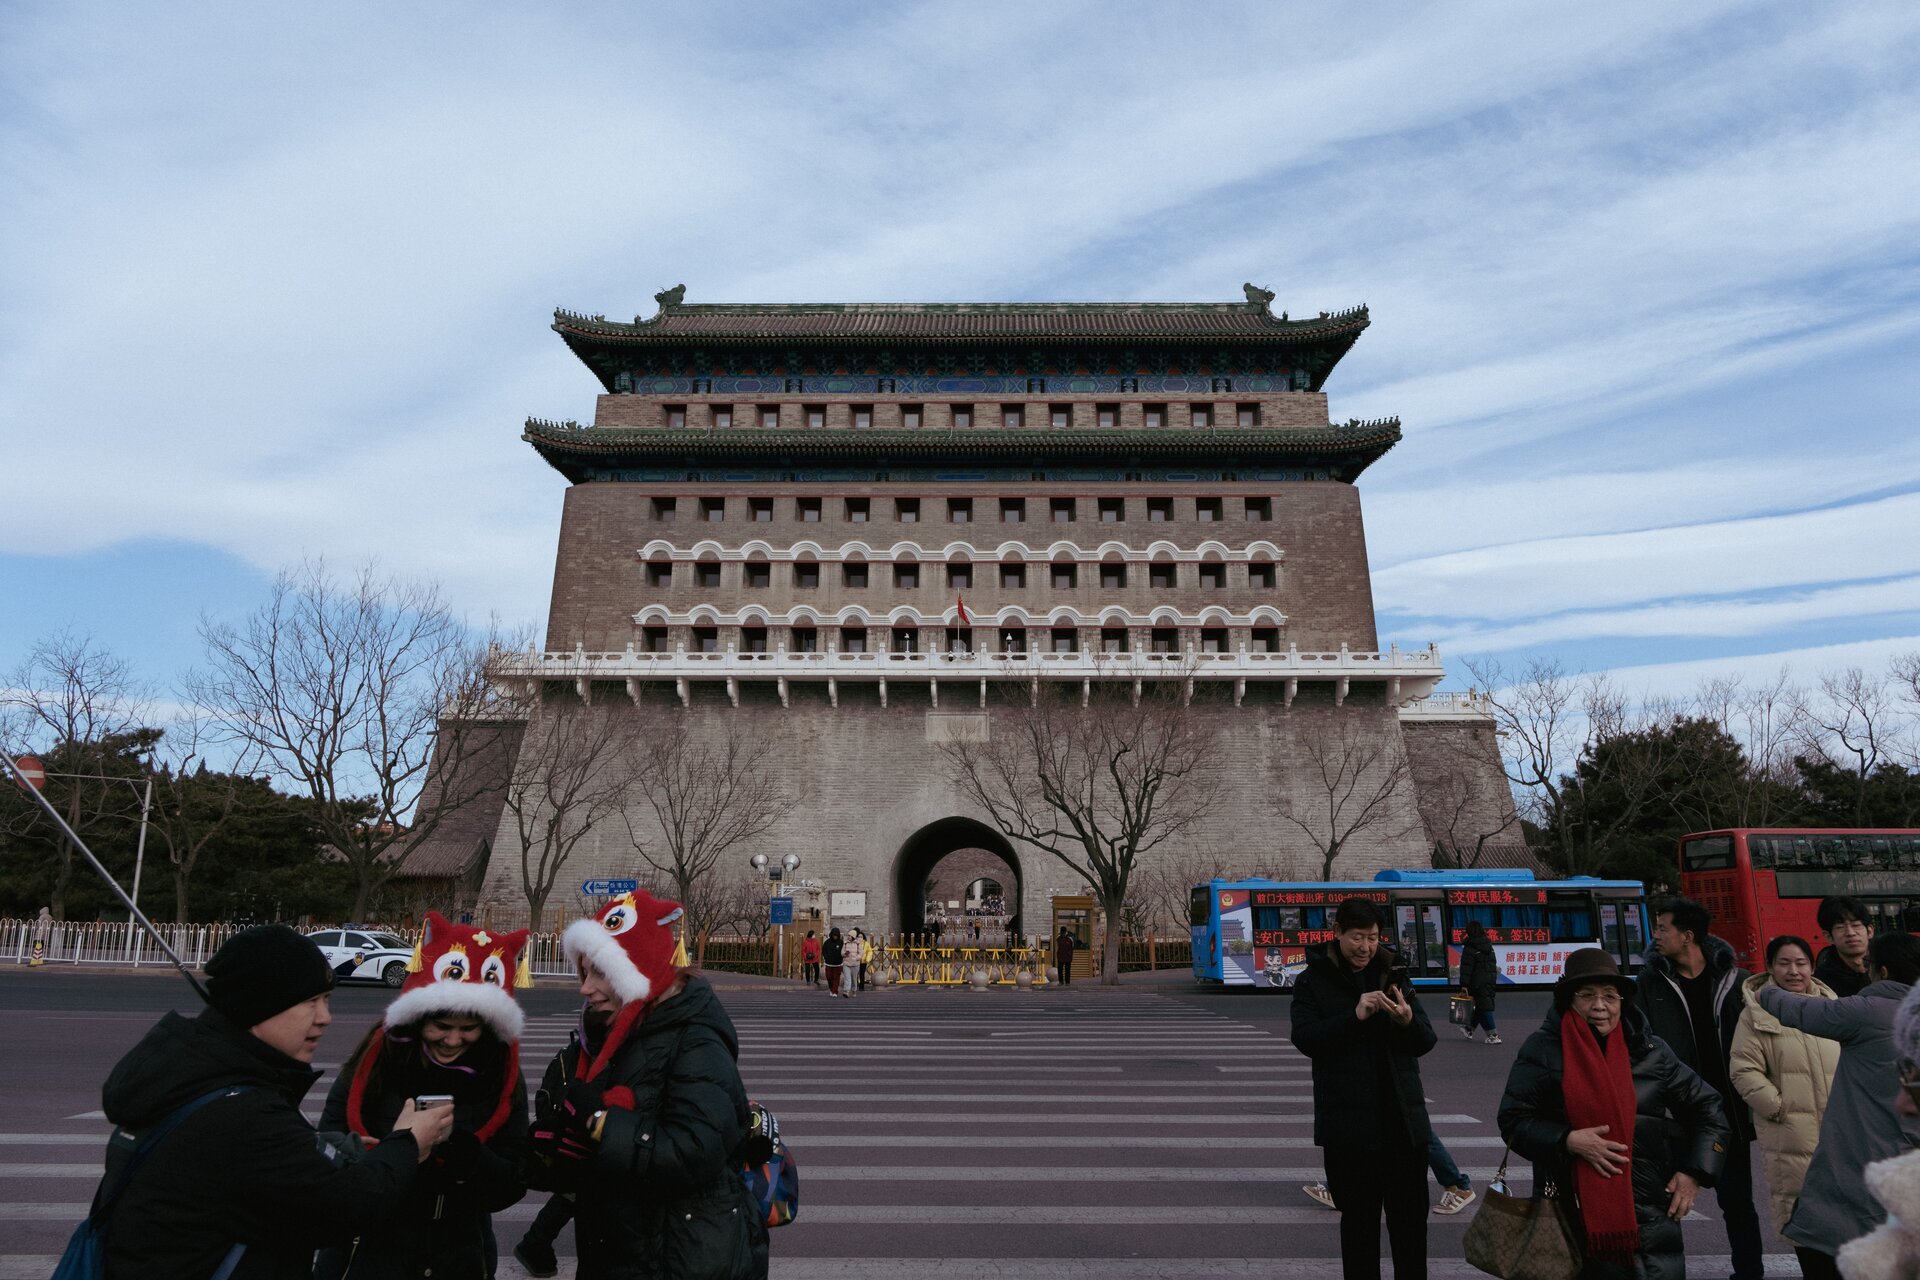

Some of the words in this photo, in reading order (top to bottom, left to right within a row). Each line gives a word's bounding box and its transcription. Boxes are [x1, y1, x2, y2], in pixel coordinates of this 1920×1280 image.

[1257, 892, 1324, 904] 前门大街派出所
[1449, 891, 1519, 903] 交便民服务。
[1506, 952, 1547, 962] 旅游咨询
